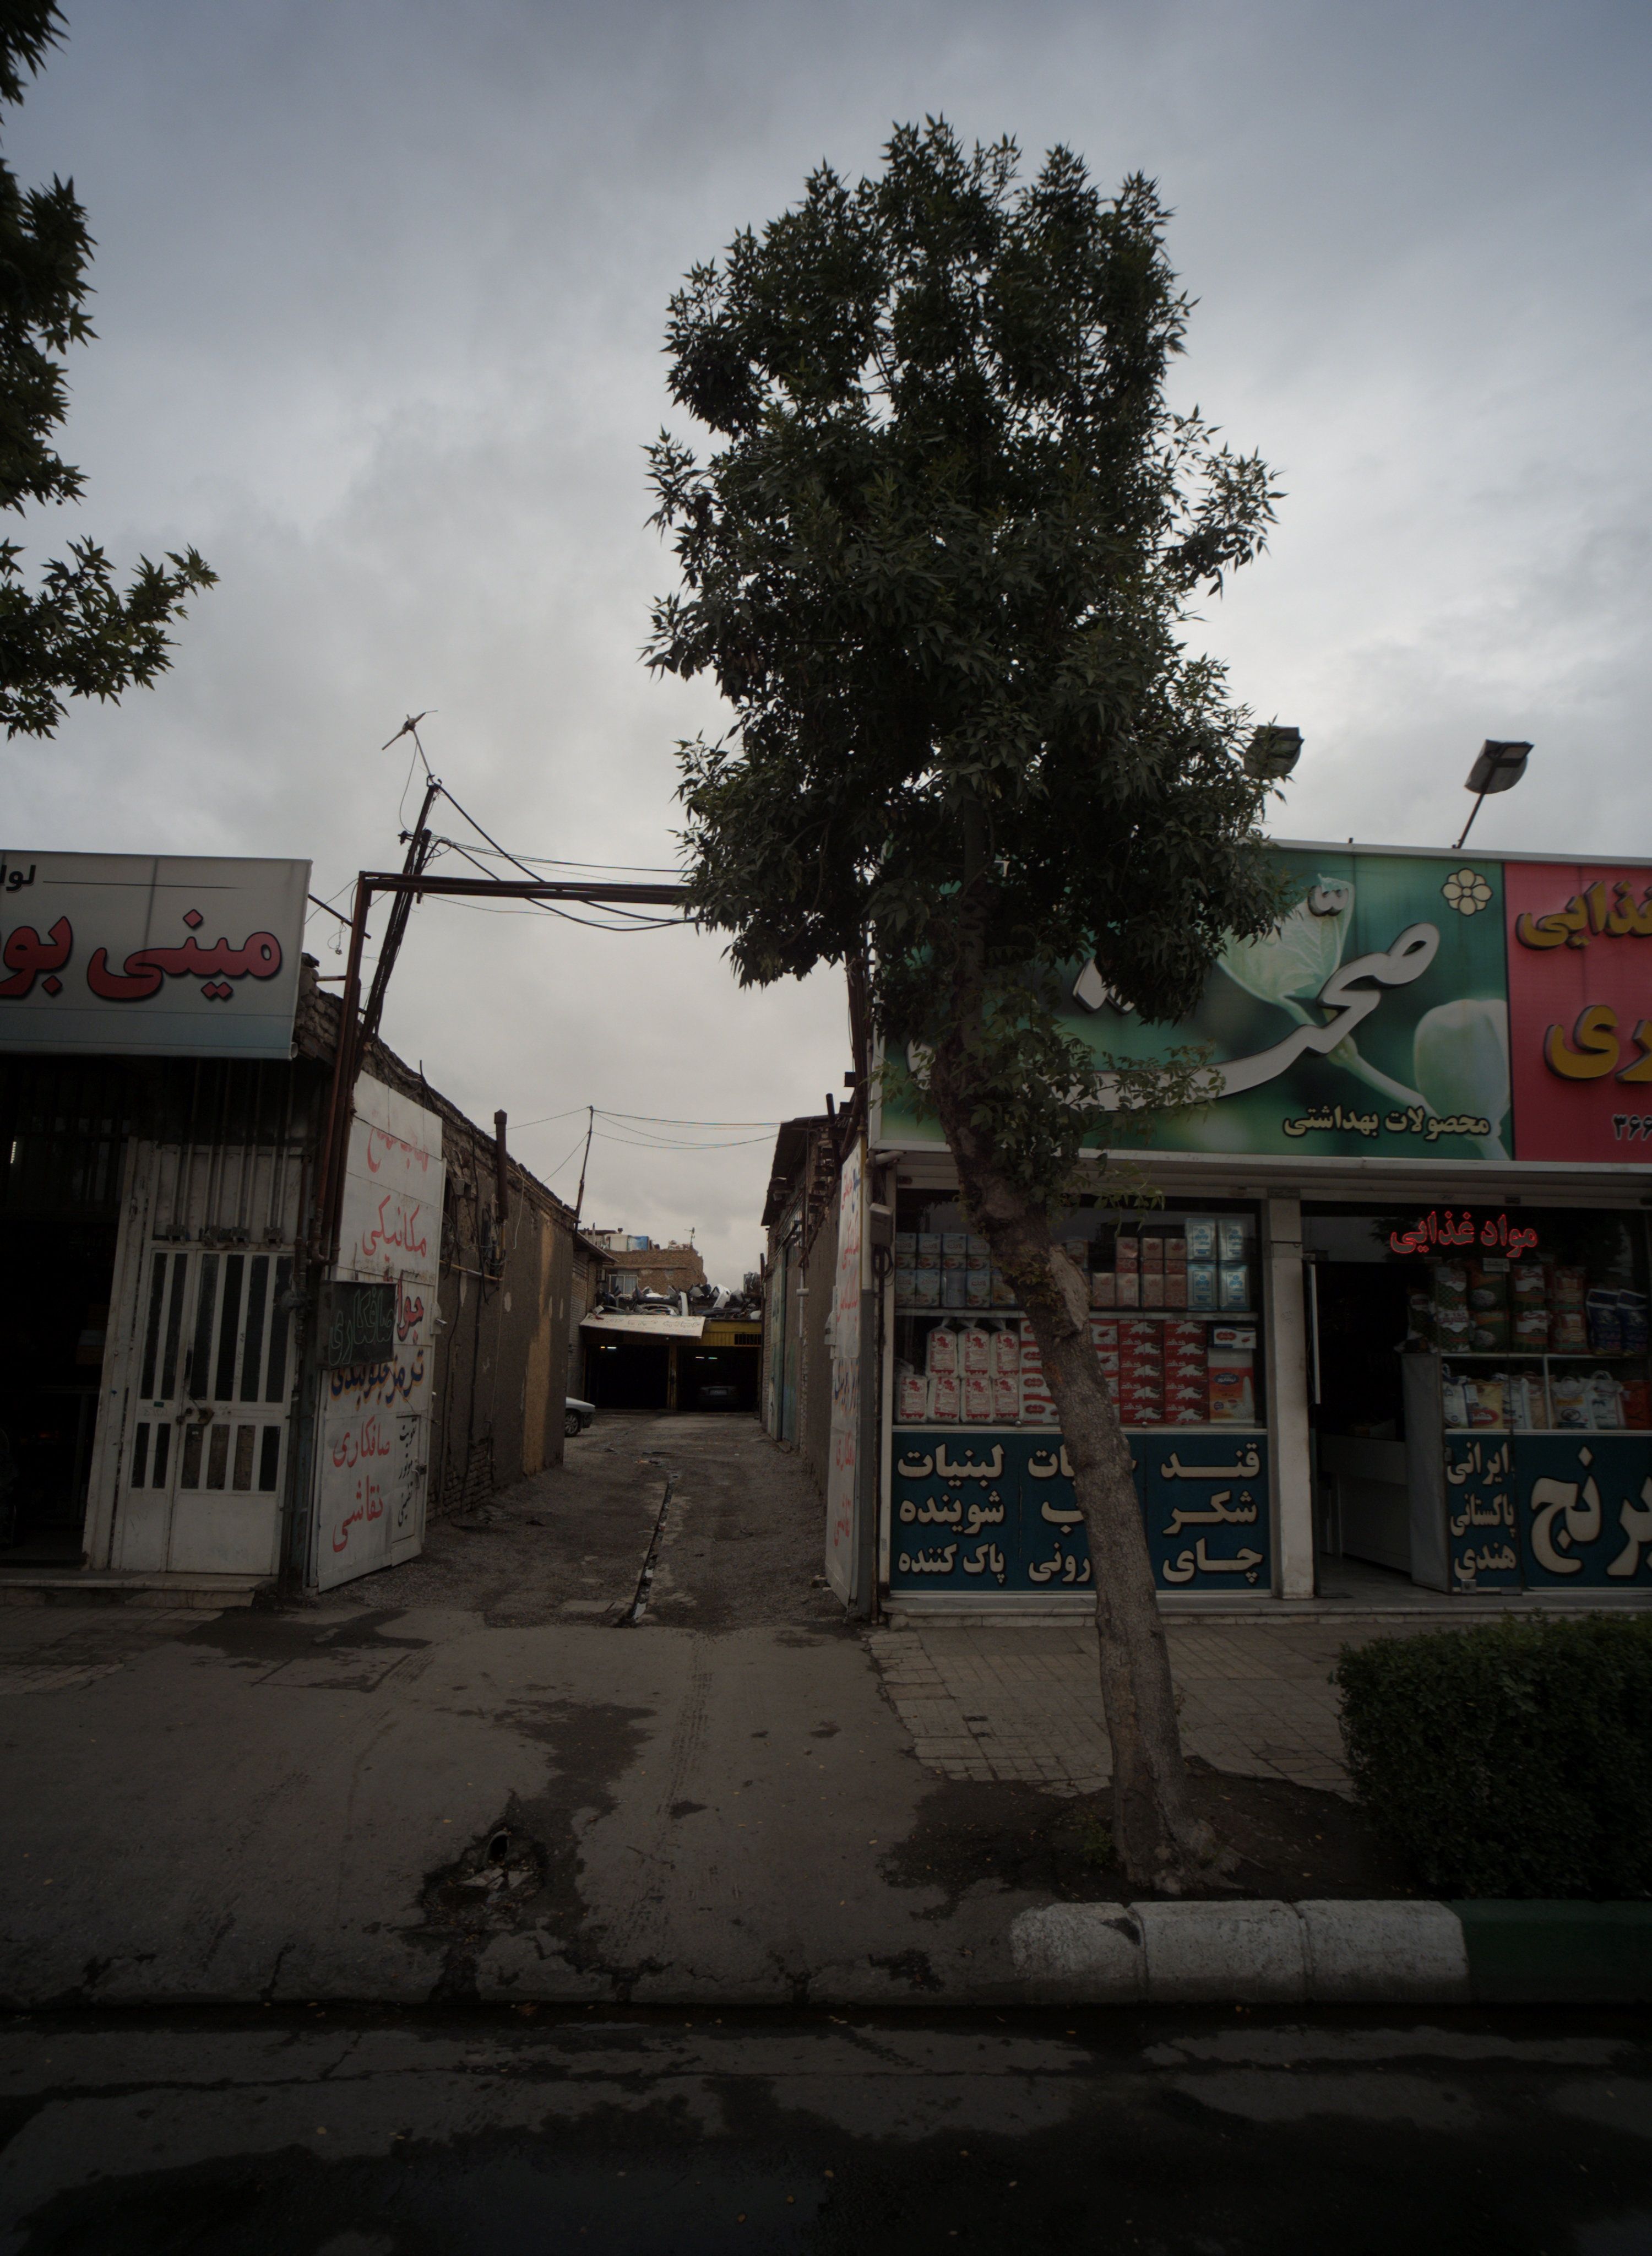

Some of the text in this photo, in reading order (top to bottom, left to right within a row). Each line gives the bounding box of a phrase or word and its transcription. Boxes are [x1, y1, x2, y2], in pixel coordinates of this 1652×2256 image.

[86, 909, 282, 1000] مینی
[1283, 1104, 1491, 1142] محصولات بهداشتی
[1390, 1211, 1539, 1258] مواد غذایی
[896, 1442, 1005, 1488] لبنیات
[1160, 1442, 1260, 1479] قند
[1447, 1441, 1510, 1485] ایرانی
[899, 1489, 1006, 1535] شوینده
[1162, 1489, 1258, 1535] شکر
[1450, 1492, 1515, 1538] پاکستانی
[1530, 1444, 1652, 1577] رنج
[898, 1543, 1006, 1585] پاک کننده
[1162, 1537, 1264, 1584] چای
[1454, 1542, 1518, 1580] هندی
